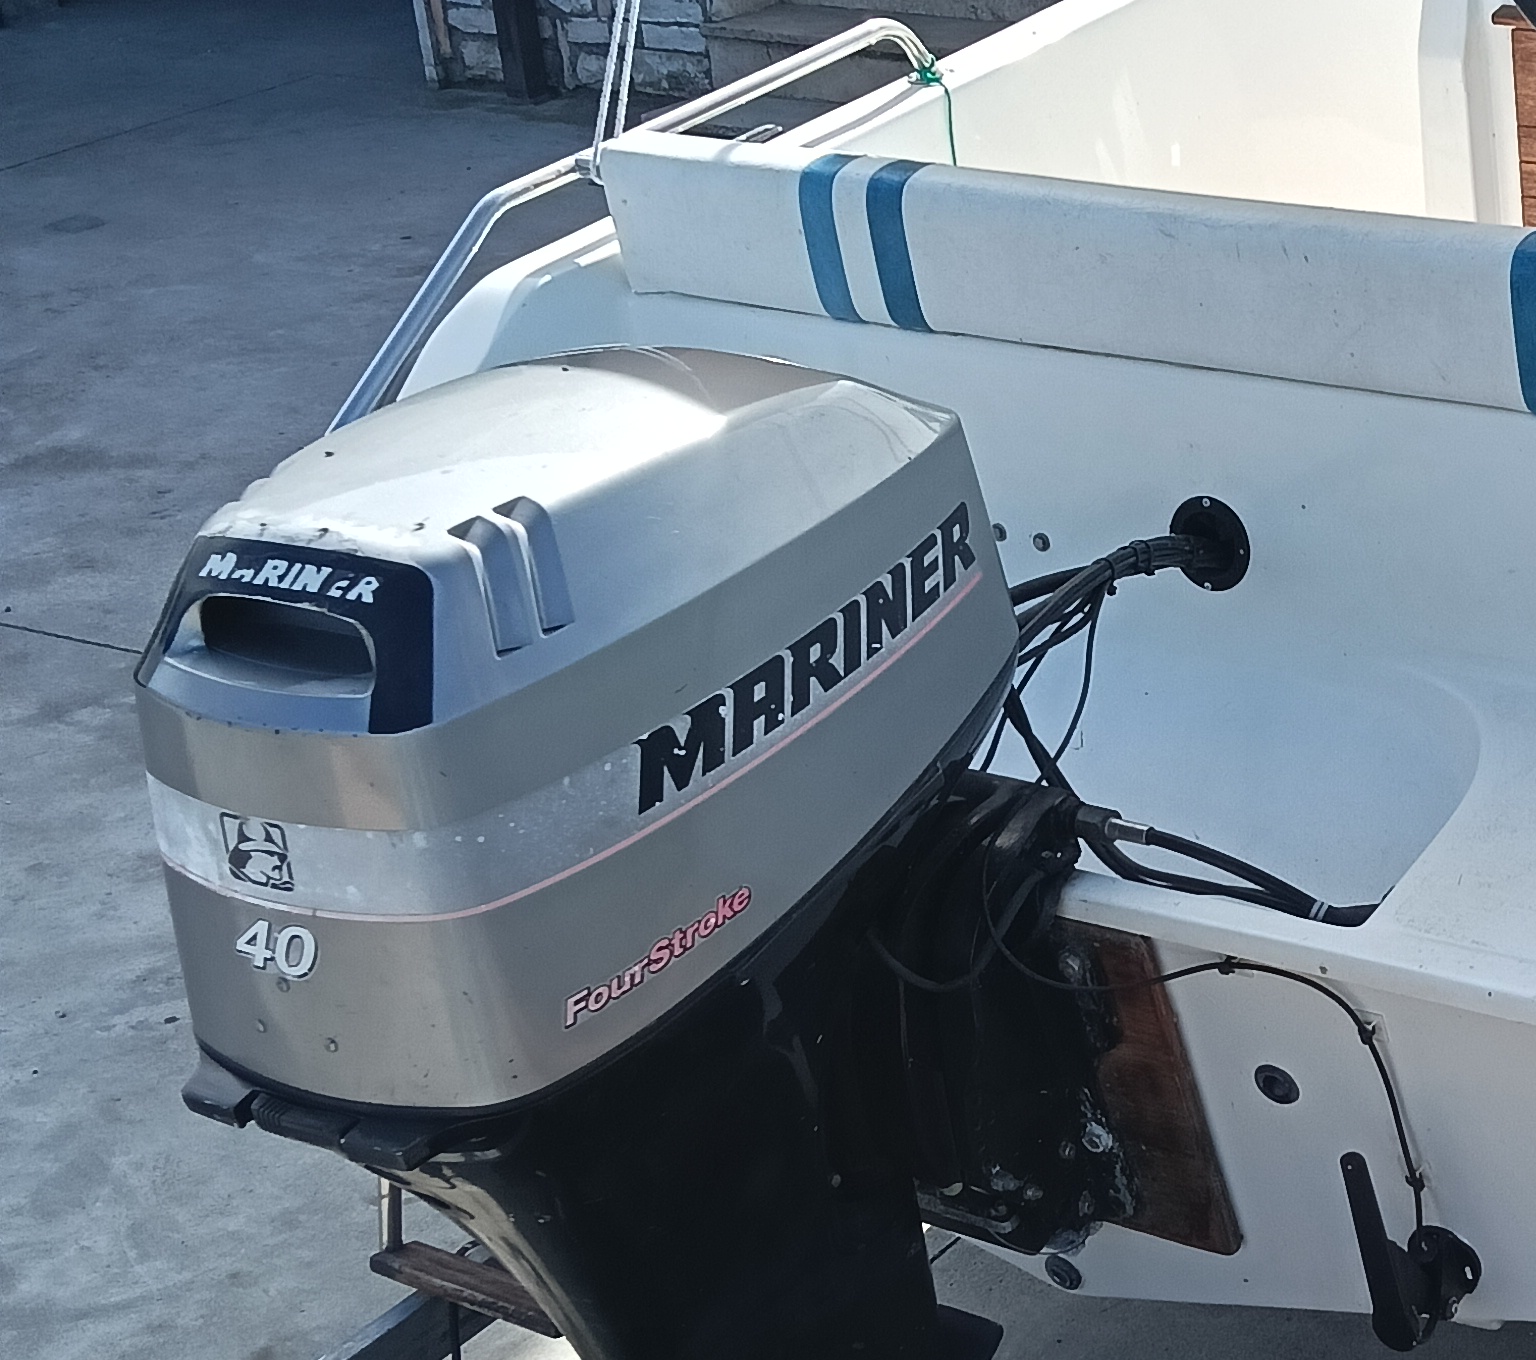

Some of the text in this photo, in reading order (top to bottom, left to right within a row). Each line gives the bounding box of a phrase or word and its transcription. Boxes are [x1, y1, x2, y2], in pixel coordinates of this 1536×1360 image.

[632, 501, 977, 816] MARINER
[234, 917, 319, 980] 40
[564, 885, 752, 1030] FourStroke
